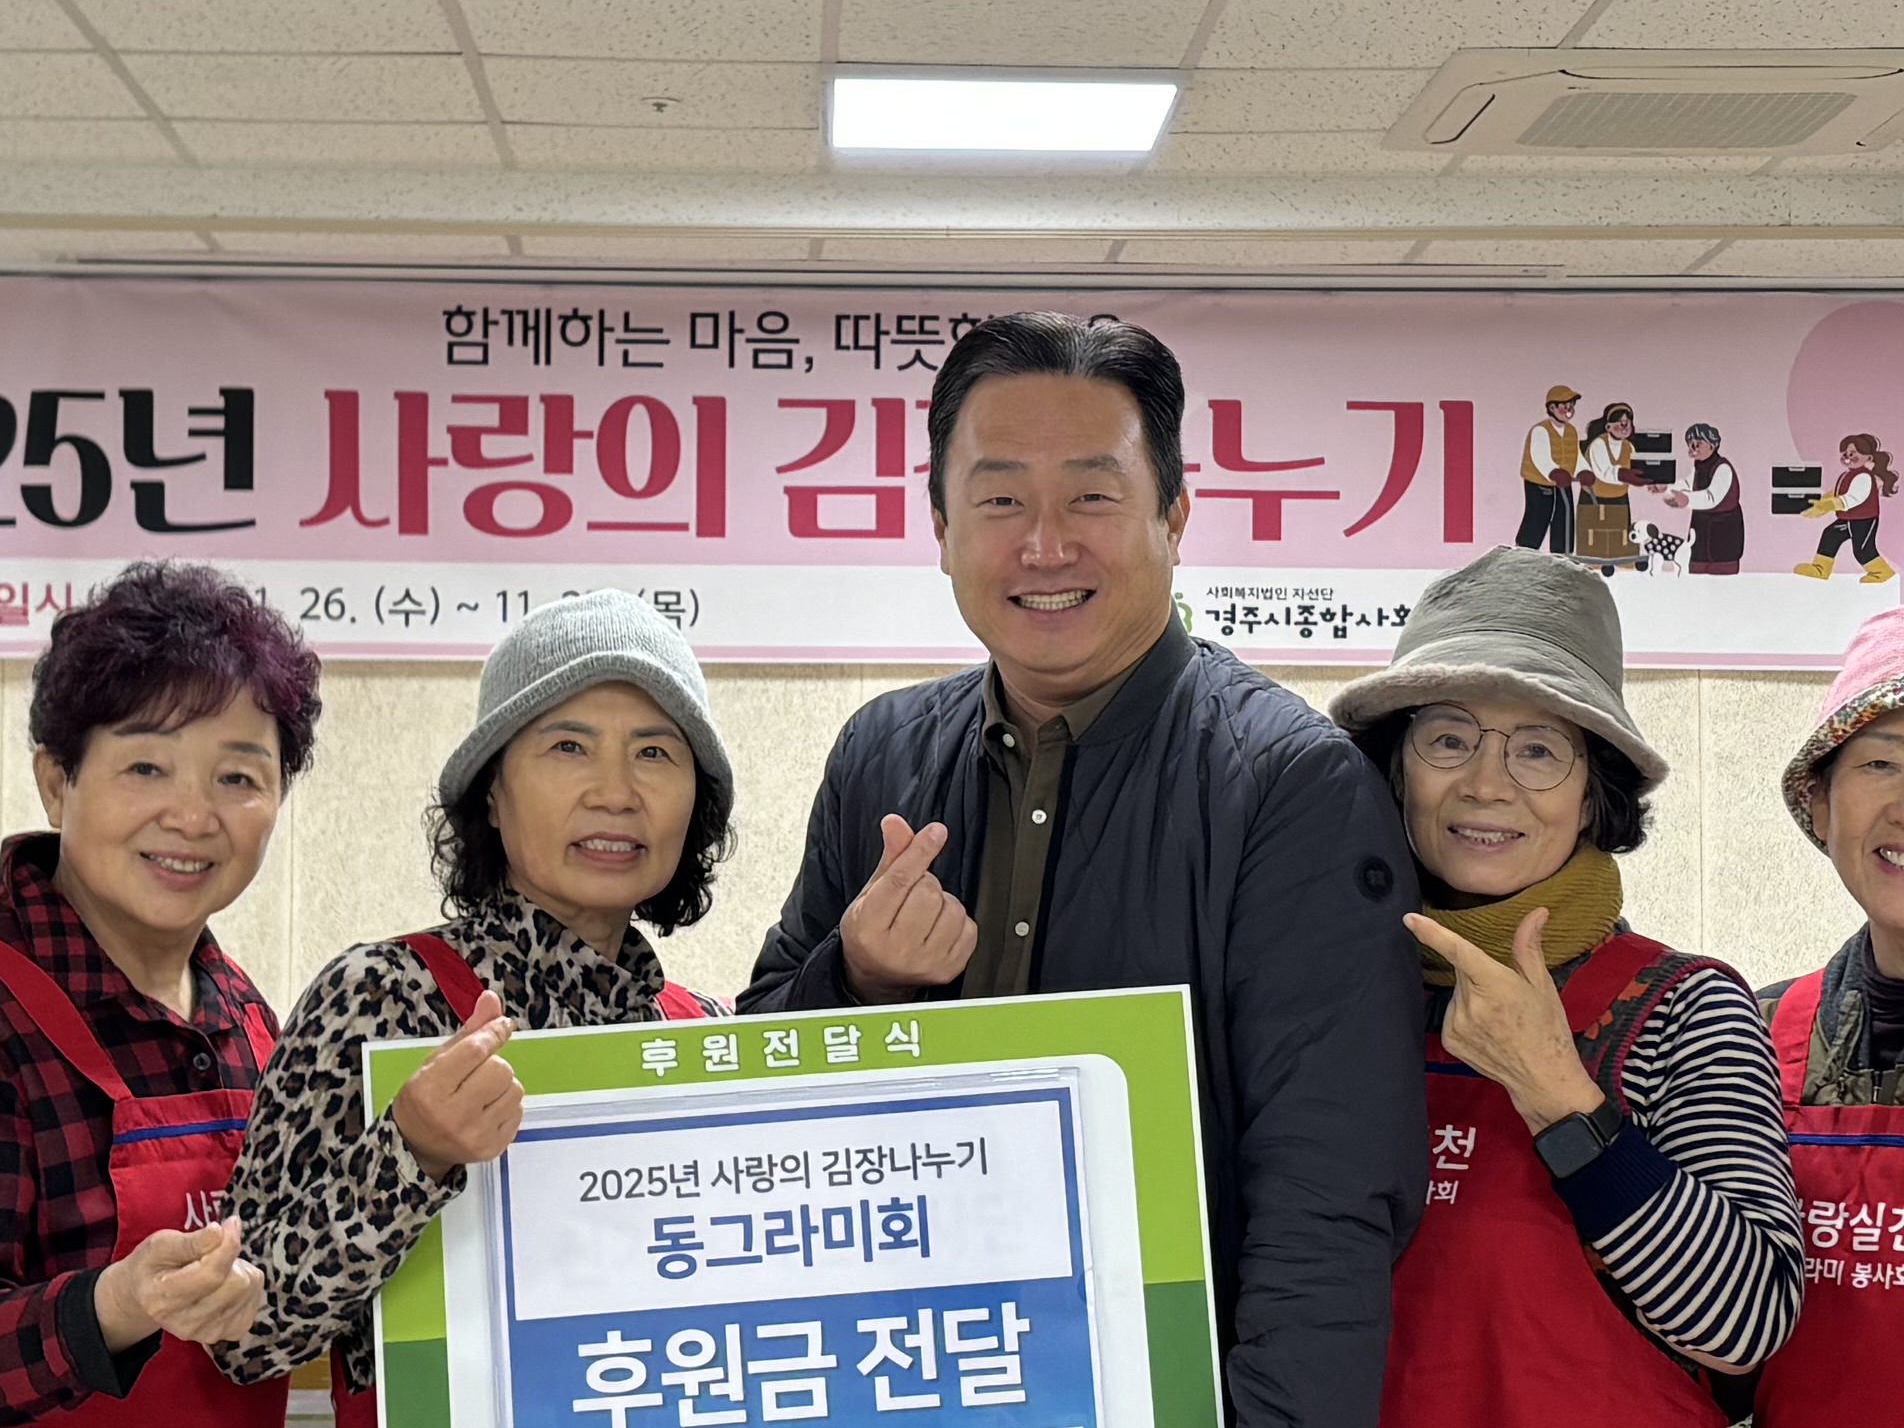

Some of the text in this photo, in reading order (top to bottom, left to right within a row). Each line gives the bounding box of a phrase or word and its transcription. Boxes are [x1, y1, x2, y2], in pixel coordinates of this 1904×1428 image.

[444, 306, 994, 374] 함께하는 마음, 따뜻
[298, 388, 728, 541] 사랑의
[775, 397, 1475, 544] 김누기
[299, 586, 357, 624] 26.
[374, 584, 441, 628] (수)
[496, 589, 529, 623] 11
[1205, 602, 1411, 639] 경주시종합사회
[1206, 585, 1288, 601] 사회복지법인
[578, 1136, 990, 1204] 2025년 사랑의 김장나누기
[645, 1193, 933, 1280] 동그라미회
[1805, 1257, 1846, 1286] 라미
[856, 1299, 1031, 1412] 전달
